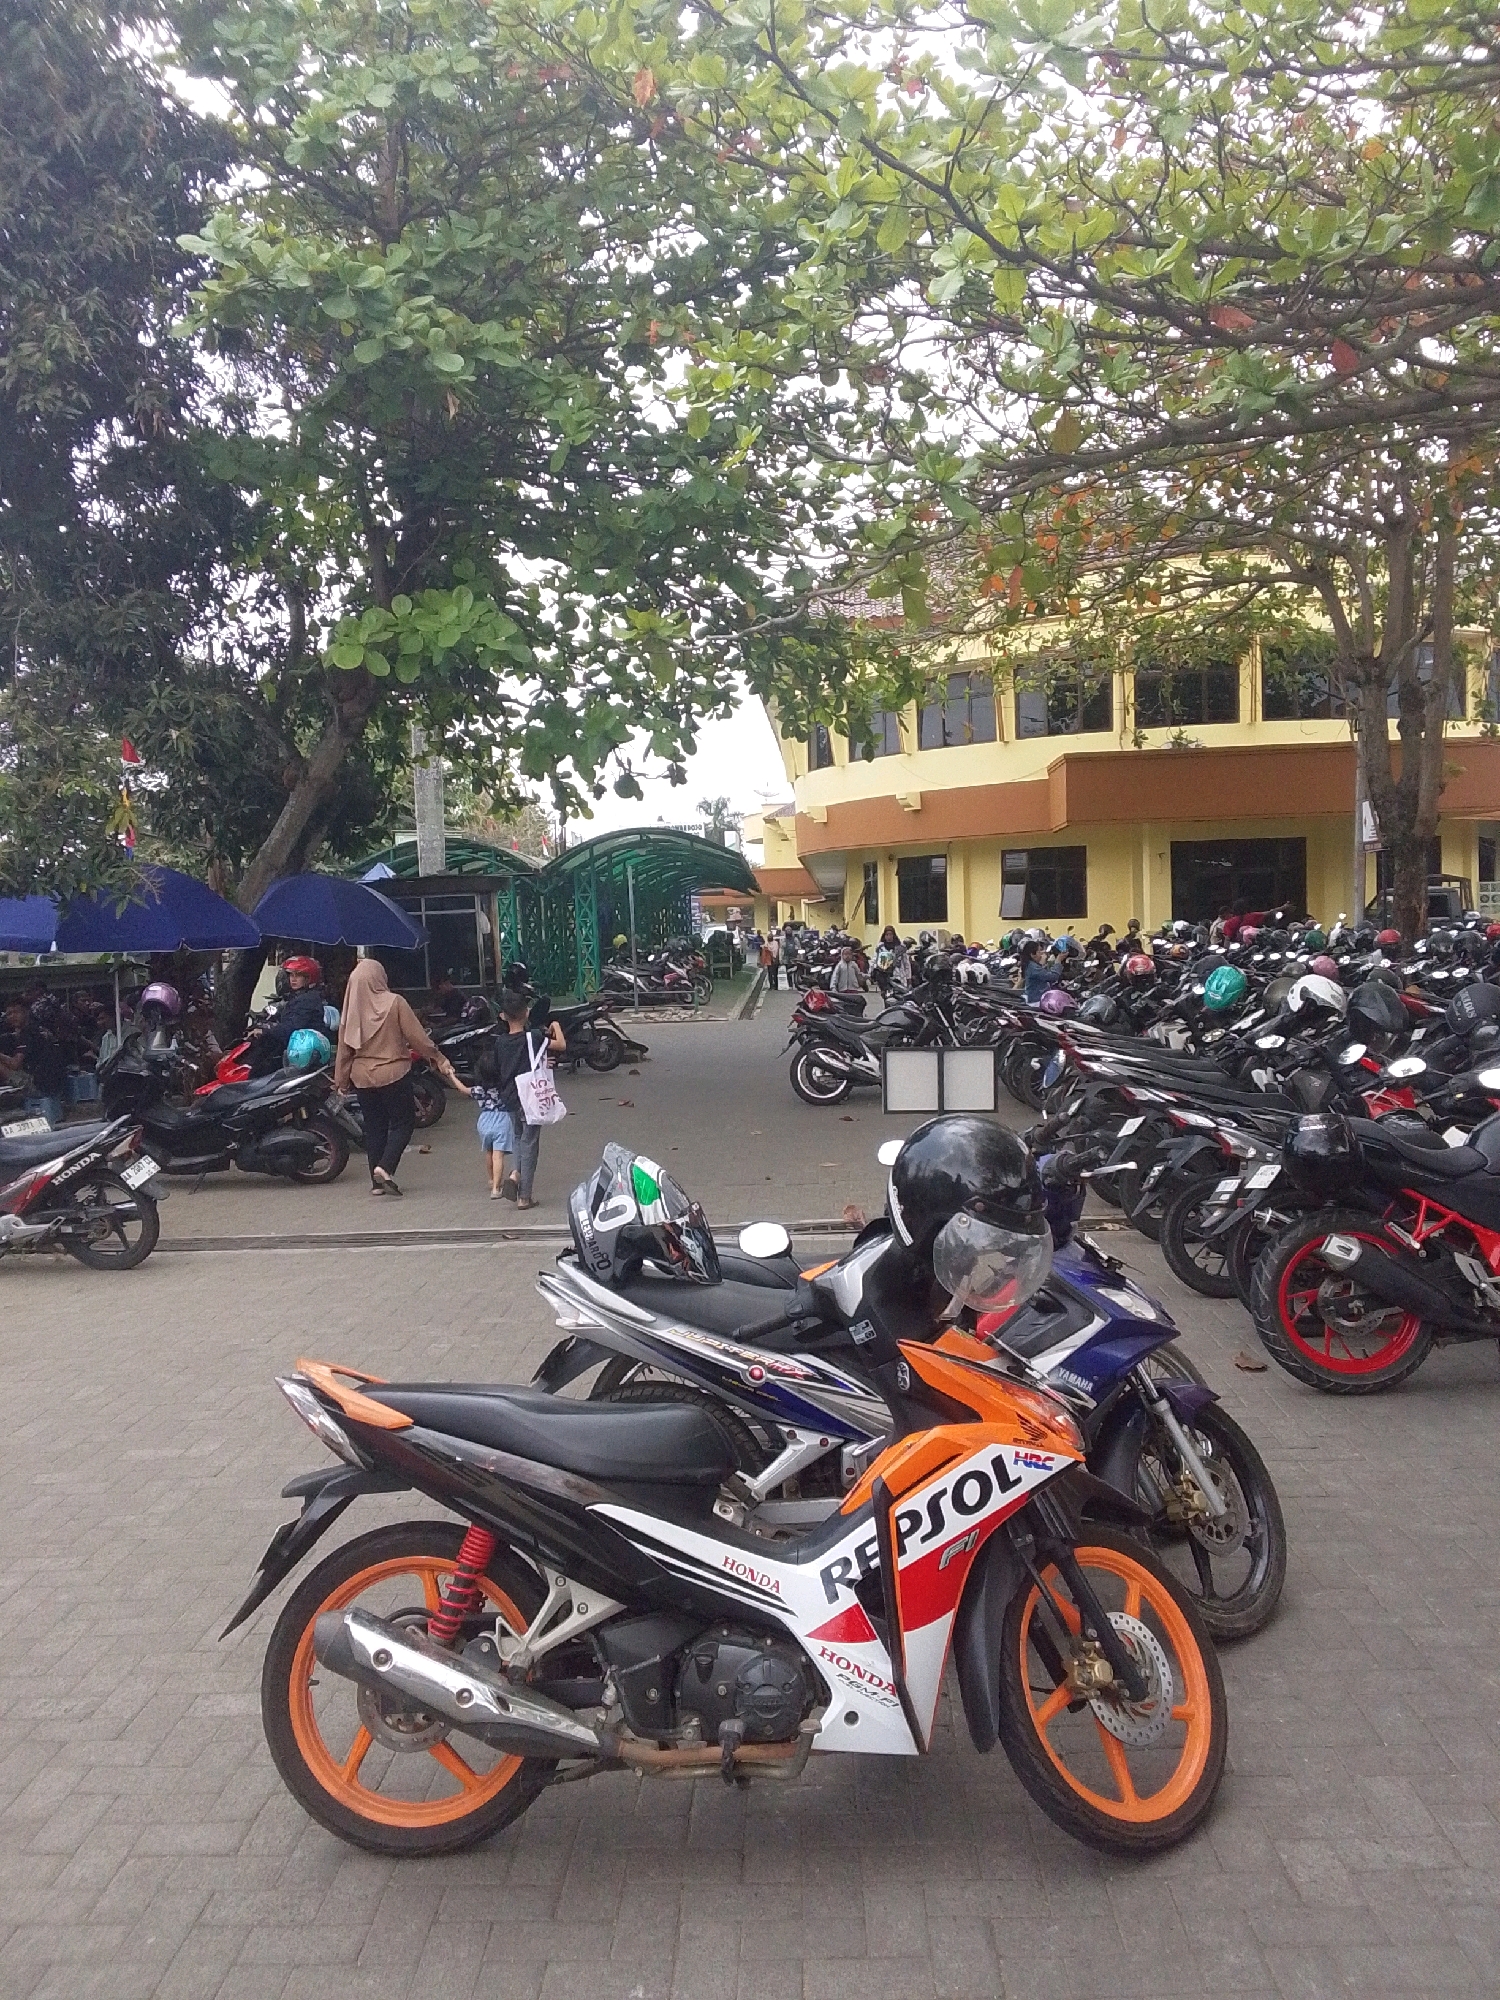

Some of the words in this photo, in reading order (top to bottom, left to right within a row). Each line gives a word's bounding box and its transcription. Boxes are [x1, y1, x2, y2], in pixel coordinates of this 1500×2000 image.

[51, 1152, 102, 1186] HONDA
[1058, 1367, 1094, 1392] YAMAHA
[1013, 1451, 1055, 1471] HRC
[820, 1454, 1023, 1605] REPSOL
[722, 1556, 781, 1594] HONDA
[818, 1646, 898, 1698] HONDA
[836, 1673, 900, 1708] PGM-FI
